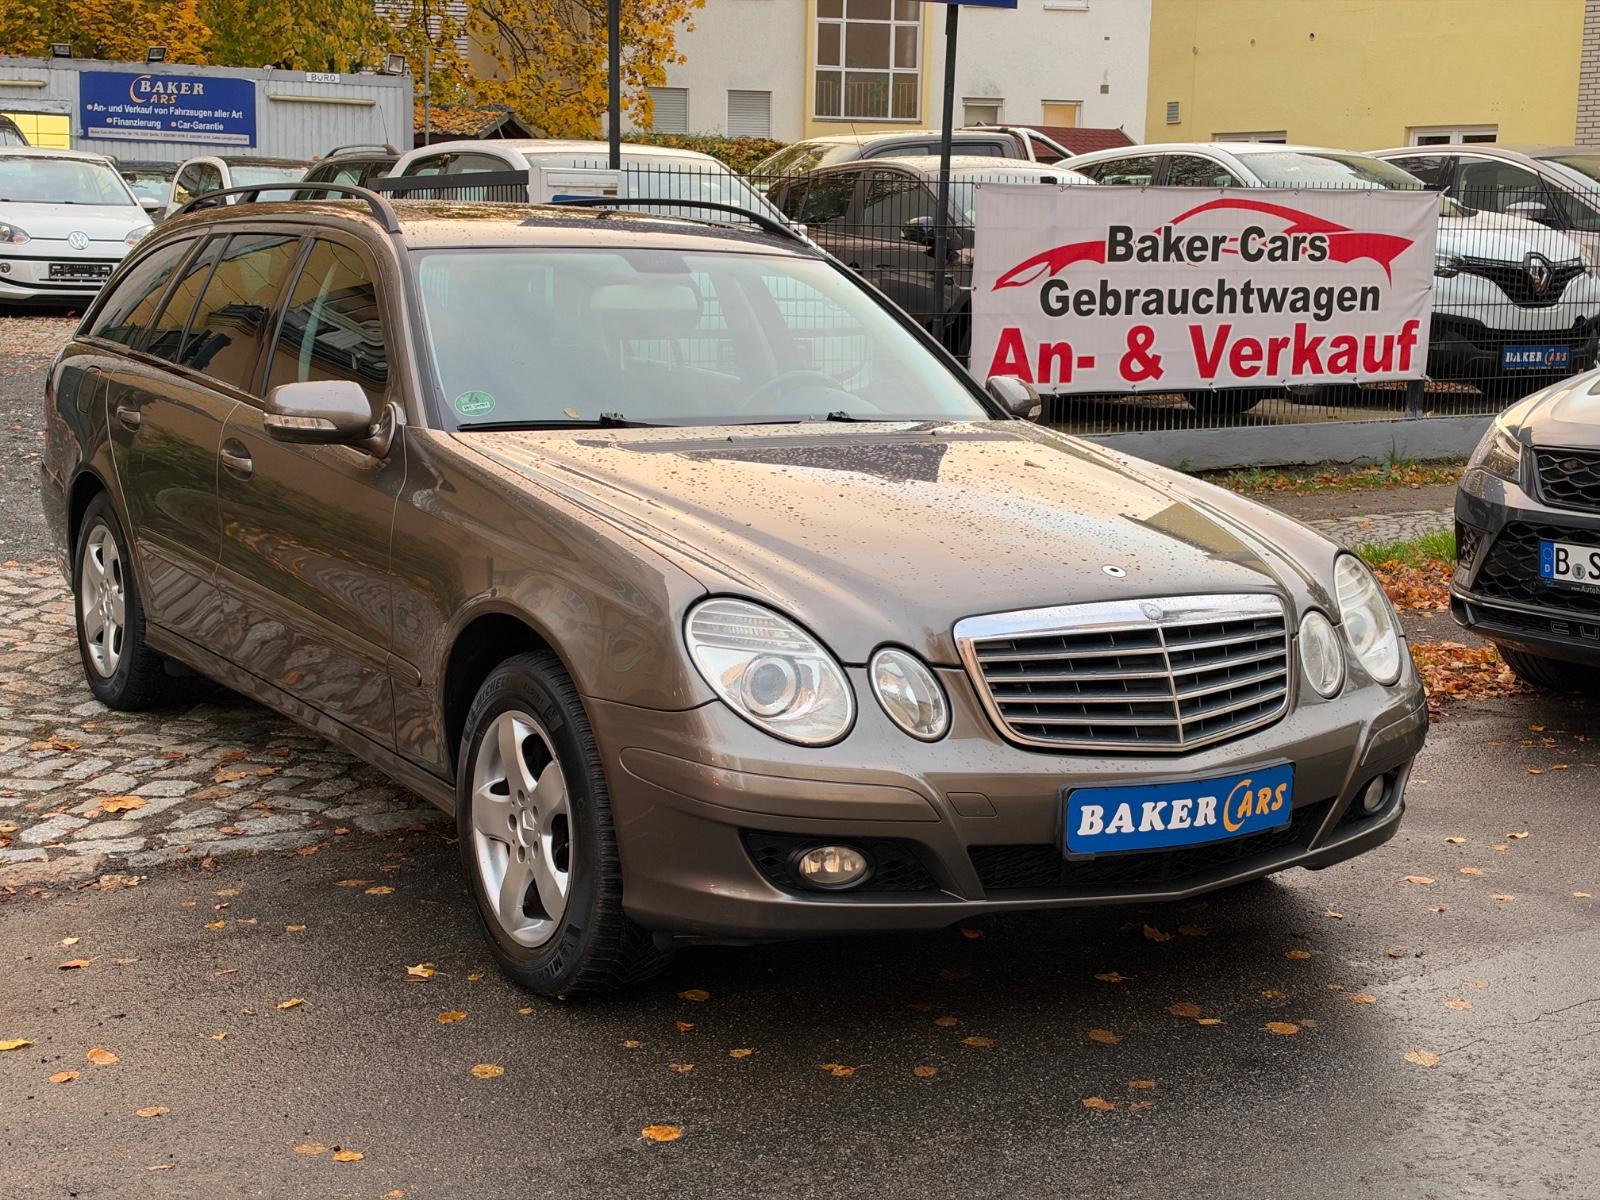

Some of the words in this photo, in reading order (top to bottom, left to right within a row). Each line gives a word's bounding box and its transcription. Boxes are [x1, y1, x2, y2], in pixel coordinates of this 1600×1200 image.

[140, 80, 204, 95] BAKER
[92, 103, 106, 112] An-
[108, 104, 123, 113] und
[124, 105, 152, 114] Verkauf
[153, 107, 168, 115] von
[169, 107, 213, 118] Fahrzeugen
[213, 109, 230, 118] aller
[231, 109, 243, 119] Art
[113, 117, 161, 129] Finanzierung
[177, 120, 224, 131] Car-Garantie
[1107, 224, 1232, 263] Baker
[1240, 225, 1329, 263] Cars
[1040, 278, 1381, 321] Gebrauchtwagen
[987, 327, 1096, 384] An-
[1119, 325, 1165, 382] &
[1188, 319, 1421, 379] Verkauf
[1505, 351, 1542, 363] BAKER
[1555, 547, 1570, 576] B
[1077, 796, 1217, 836] BAKER
[1222, 779, 1287, 832] CARS
